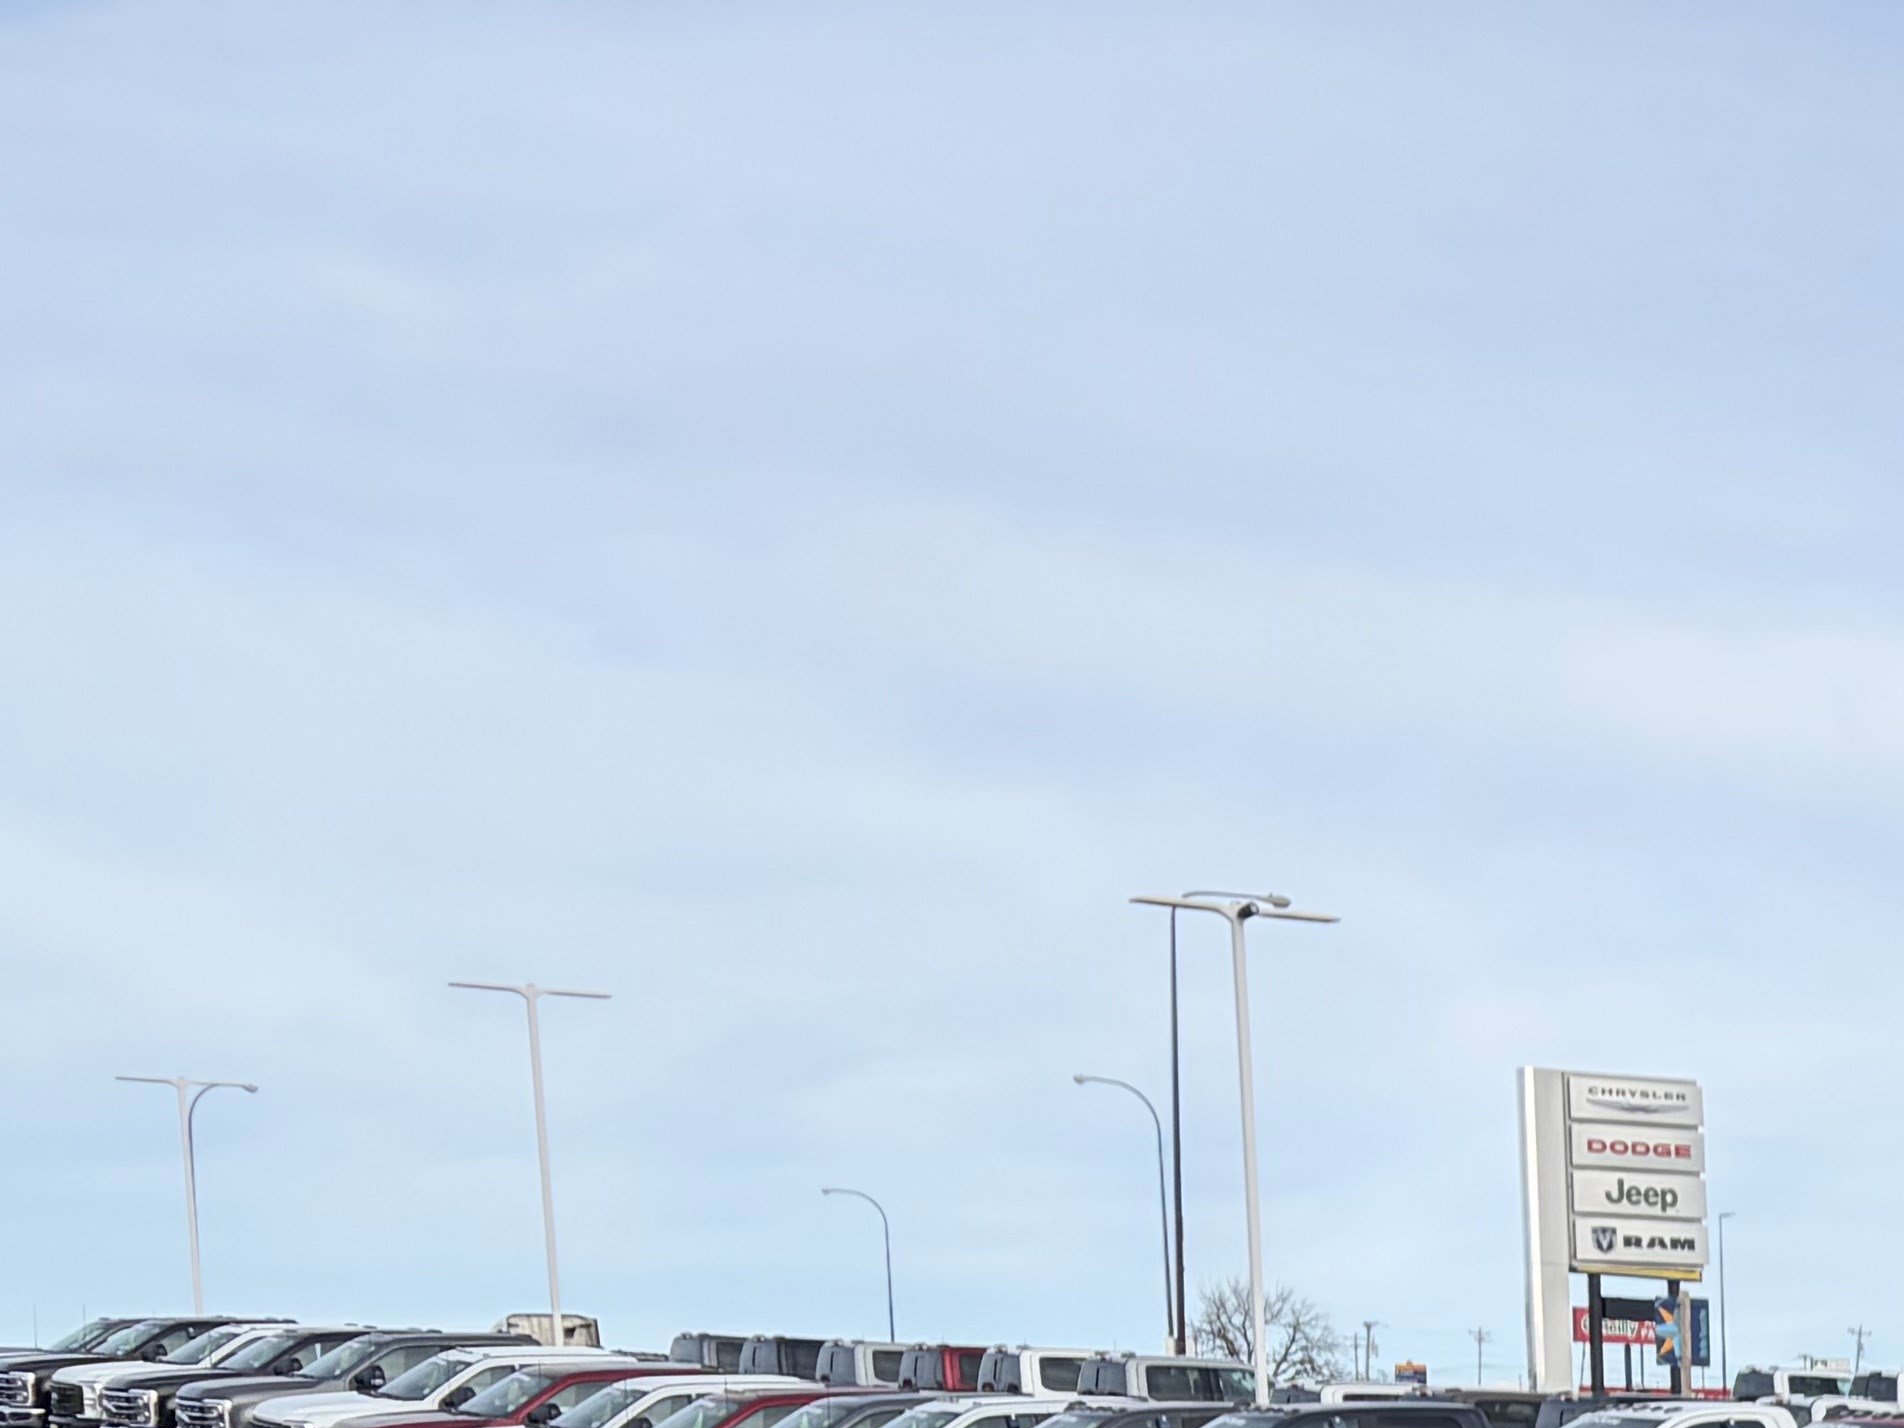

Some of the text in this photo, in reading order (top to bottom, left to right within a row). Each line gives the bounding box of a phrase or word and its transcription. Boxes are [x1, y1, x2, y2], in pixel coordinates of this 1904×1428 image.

[1587, 1086, 1687, 1102] CHRYSLER
[1587, 1138, 1692, 1160] DODGE
[1605, 1178, 1678, 1212] Jeep
[1623, 1234, 1696, 1252] RAM
